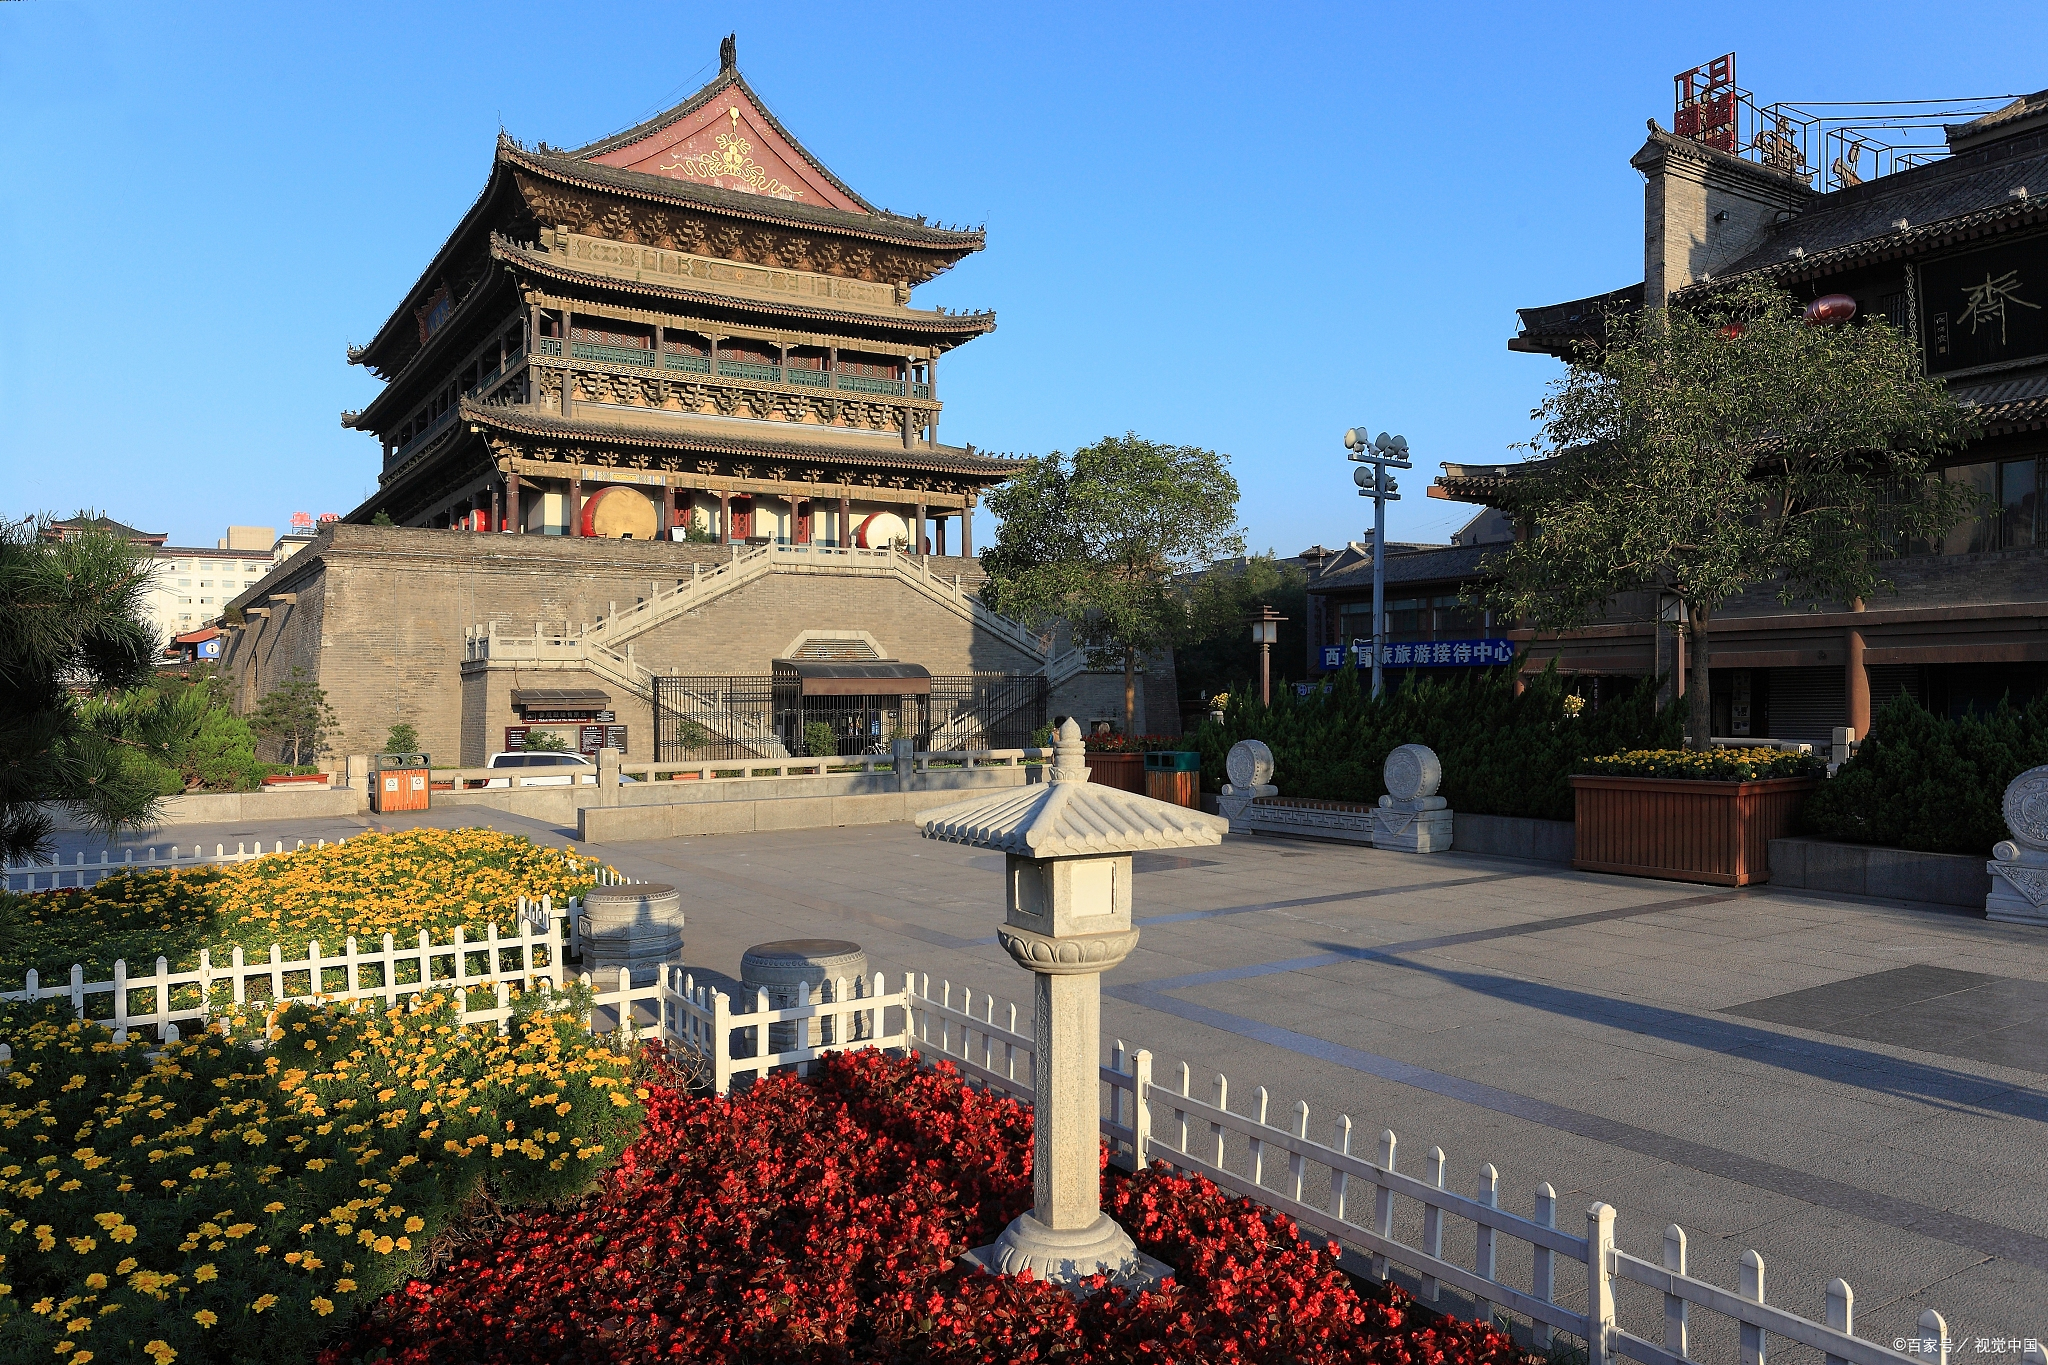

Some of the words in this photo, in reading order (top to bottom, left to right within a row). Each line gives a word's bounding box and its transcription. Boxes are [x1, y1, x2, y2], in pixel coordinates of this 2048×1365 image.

[1324, 640, 1514, 667] 西國旅旅游接待中心
